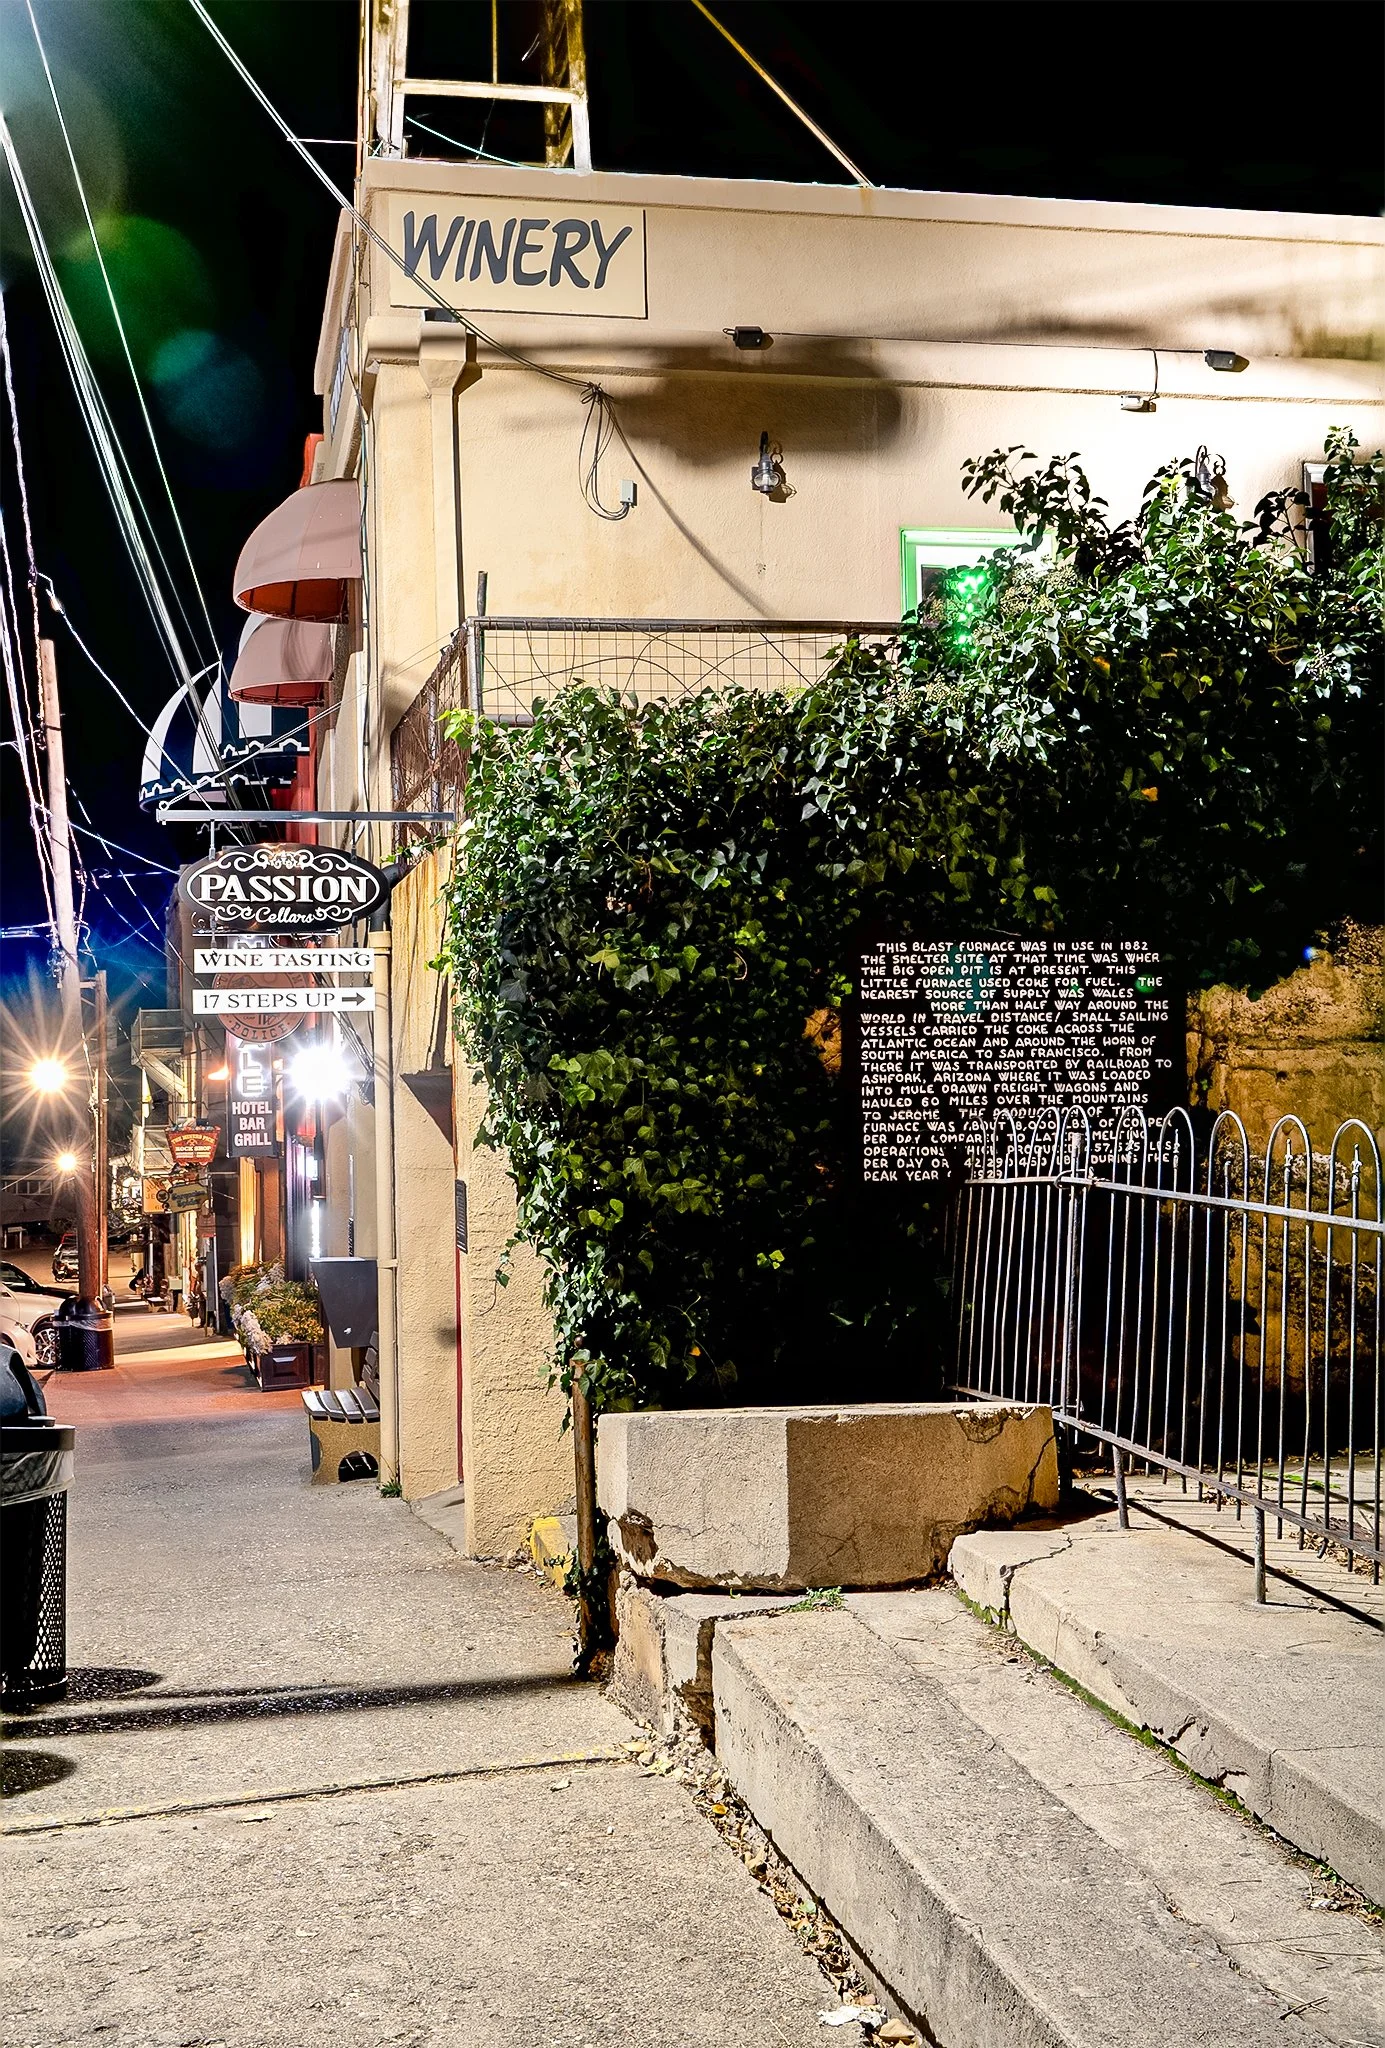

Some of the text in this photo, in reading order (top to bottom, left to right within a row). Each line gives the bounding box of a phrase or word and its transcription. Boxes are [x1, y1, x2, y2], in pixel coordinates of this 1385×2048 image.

[403, 210, 632, 290] WINERY
[198, 874, 369, 902] PASSION
[255, 907, 315, 923] Cellars
[877, 942, 907, 953] THIS
[913, 942, 953, 952] BLAST
[959, 941, 1015, 952] FURNACE
[1021, 941, 1047, 951] WAS
[1054, 942, 1065, 951] IN
[1072, 942, 1094, 950] USE
[1121, 941, 1148, 950] 1882
[201, 953, 371, 967] WINE TASTING
[861, 955, 885, 964] THE
[893, 954, 949, 964] SMELTER
[955, 953, 984, 963] SITE
[989, 954, 1007, 963] AT
[1013, 954, 1047, 963] THAT
[1054, 954, 1085, 963] TIME
[1092, 953, 1118, 963] WAS
[861, 965, 1135, 976] THE BIG OPEN PIT IS AT PRESENT. THIS
[861, 977, 1162, 988] LITTLE FURNACE USED COKE FOR FUEL. THE
[861, 988, 1133, 999] NEAREST SOURCE OF SUPPLY WAS WALES
[203, 993, 335, 1009] 17 STEPS UP
[931, 1000, 1168, 1011] MORE THAN HALF WAY AROUND THE
[861, 1013, 905, 1024] WORLD
[913, 1013, 926, 1023] IN
[933, 1013, 984, 1024] TRAVEL
[1073, 1012, 1113, 1022] SMALL
[1127, 1012, 1168, 1021] SAILING
[231, 1022, 288, 1039] POLICE
[861, 1023, 1134, 1036] VESSELS CARRIED THE COKE ACROSS THE
[861, 1036, 1156, 1049] ATLANTIC OCEAN AND AROUND THE HORN OF
[861, 1047, 1151, 1060] SOUTH AMERICA TO SAN FRANCISCO. FROM
[861, 1059, 1172, 1072] THERE IT WAS TRANSPORTED BY RAILROAD TO
[862, 1070, 1150, 1084] ASHFORK, ARIZONA WHERE IT WAS LOADED
[862, 1082, 1139, 1096] INTO MULE DRAWN FREIGHT WAGONS AND
[862, 1094, 1148, 1108] HAULED 60 MILES OVER THE MOUNTAINS
[232, 1102, 272, 1115] HOTEL
[863, 1112, 881, 1120] TO
[889, 1110, 940, 1120] JEROME
[1087, 1107, 1104, 1117] OF
[239, 1117, 265, 1130] BAR
[864, 1123, 919, 1133] FURNACE
[927, 1121, 955, 1132] WAS
[1099, 1119, 1114, 1127] OF
[234, 1133, 272, 1146] GRILL
[864, 1134, 887, 1144] PER
[864, 1158, 888, 1169] PER
[897, 1158, 923, 1168] DAY
[864, 1170, 897, 1181] PEAK
[906, 1170, 939, 1181] YEAR
